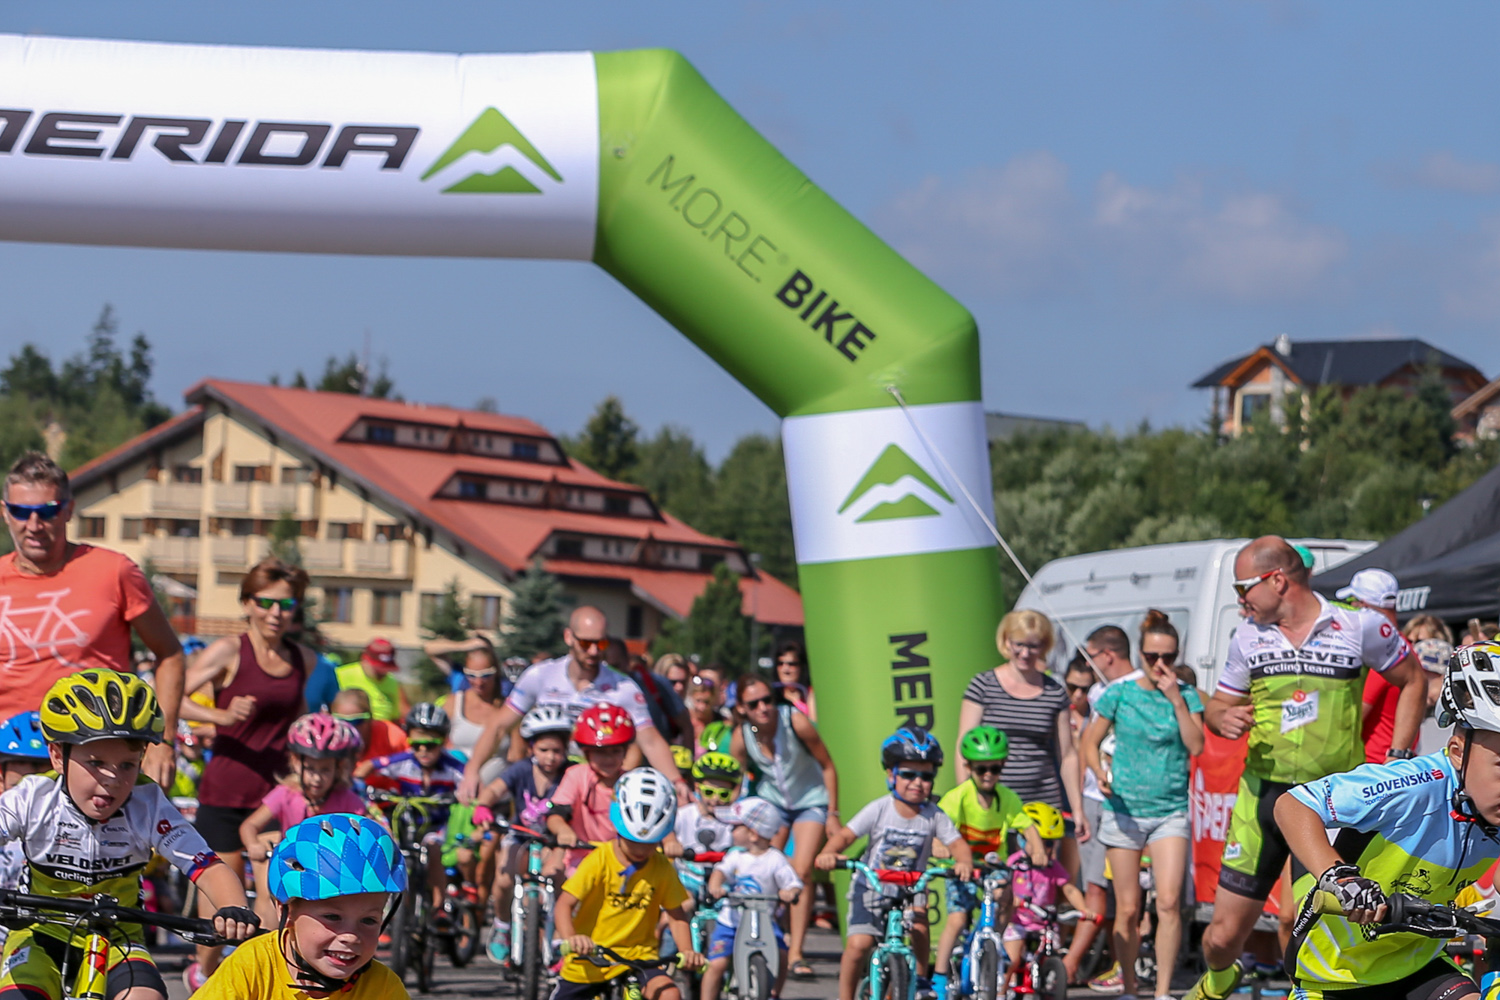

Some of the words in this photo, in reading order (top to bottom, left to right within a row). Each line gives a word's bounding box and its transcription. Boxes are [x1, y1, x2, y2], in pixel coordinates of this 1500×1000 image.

[774, 268, 878, 363] BIKE
[1394, 586, 1432, 613] COTT
[1249, 650, 1357, 667] VELOSVET
[1263, 662, 1302, 675] cycling
[1303, 663, 1336, 676] team
[888, 632, 935, 731] MER
[1362, 770, 1433, 799] SLOVENSKÁ
[45, 853, 134, 870] VELOSVET
[54, 870, 93, 886] cycling
